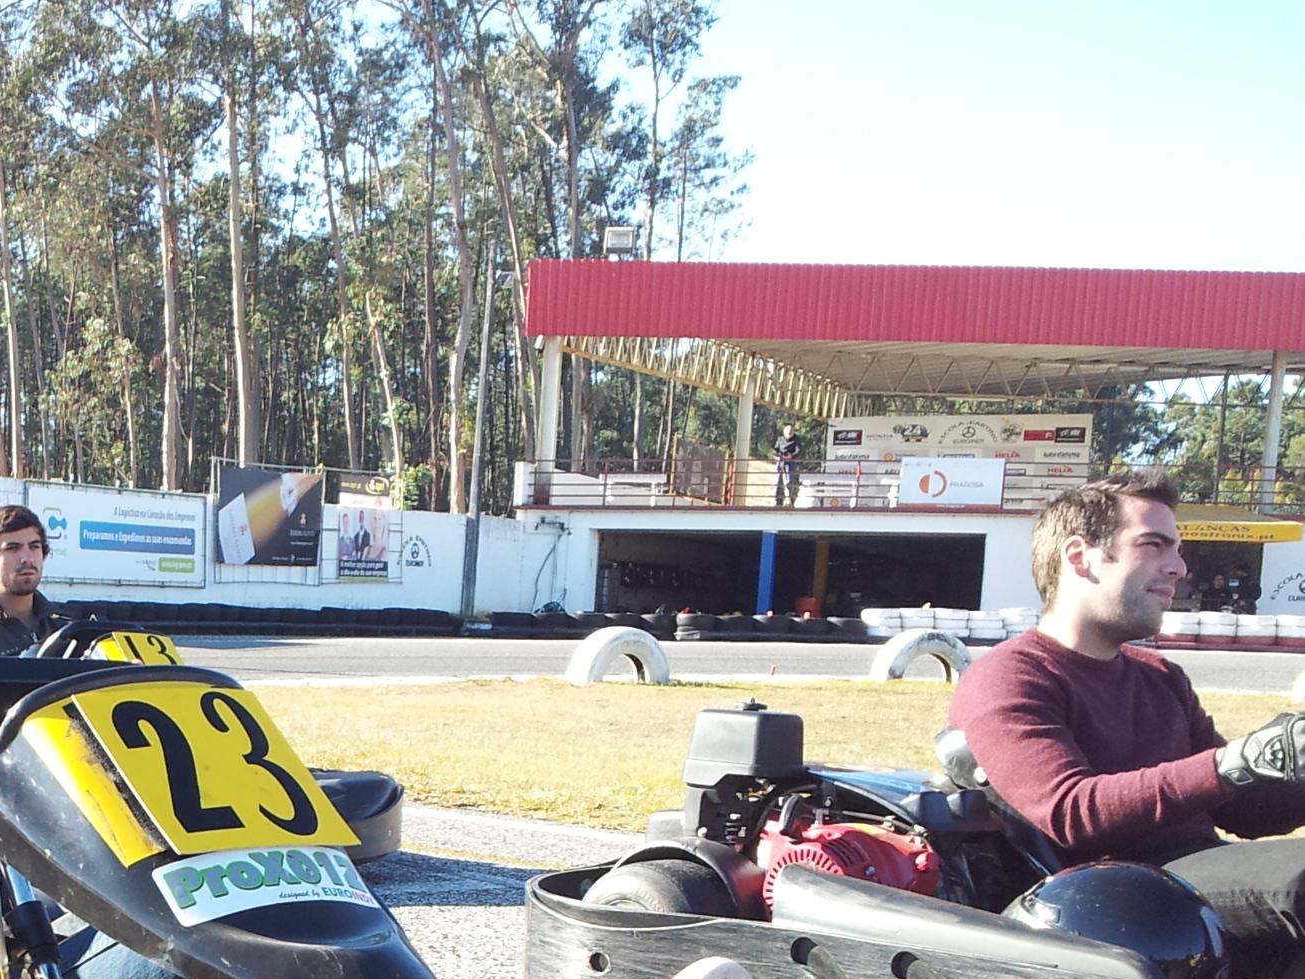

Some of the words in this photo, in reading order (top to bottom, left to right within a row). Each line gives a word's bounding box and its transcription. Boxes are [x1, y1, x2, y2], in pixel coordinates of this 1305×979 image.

[903, 425, 921, 436] 24
[124, 635, 177, 664] 13
[111, 691, 319, 836] 23
[279, 889, 310, 900] designed
[311, 889, 320, 898] by
